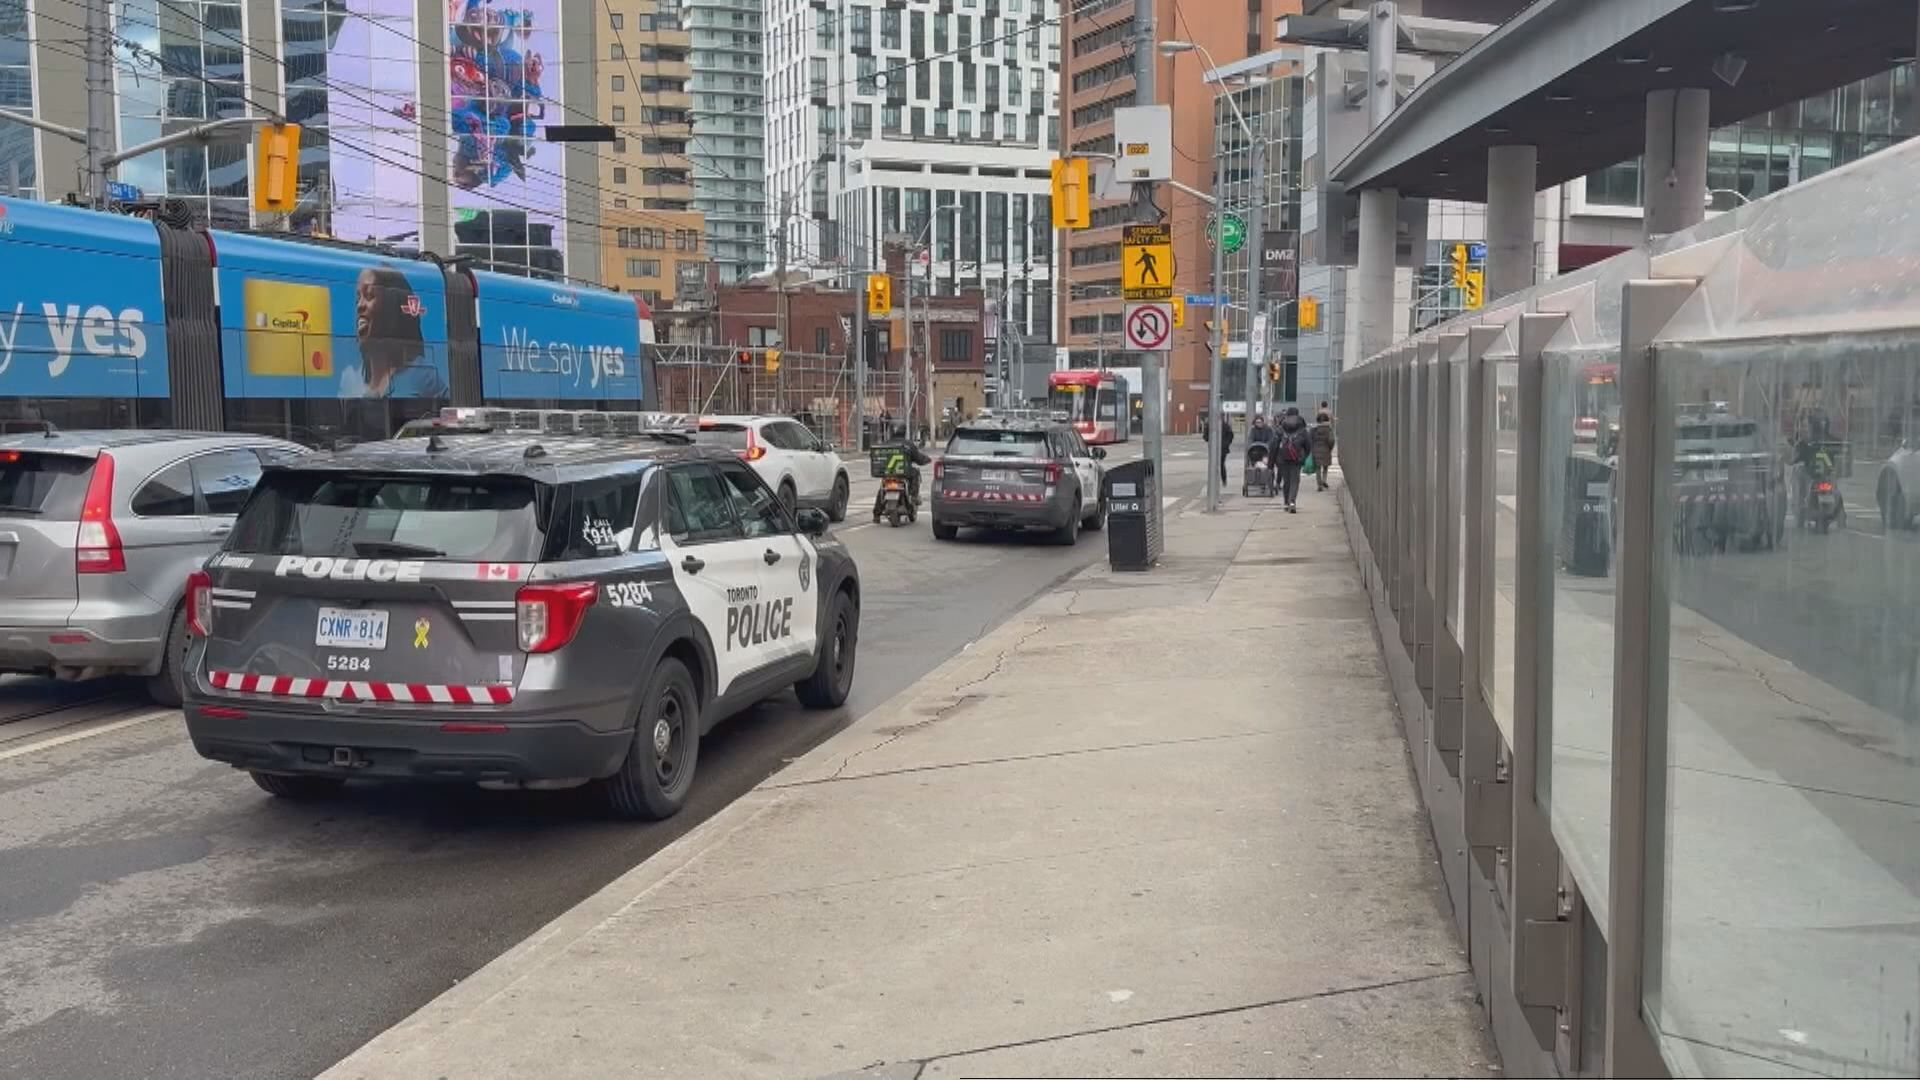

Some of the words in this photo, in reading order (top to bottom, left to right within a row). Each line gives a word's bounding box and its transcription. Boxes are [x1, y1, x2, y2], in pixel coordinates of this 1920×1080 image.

[1265, 249, 1295, 260] DMZ
[42, 302, 147, 378] yes
[502, 325, 540, 372] We
[548, 341, 583, 388] say
[589, 345, 625, 388] yes
[274, 555, 425, 582] POLICE
[606, 581, 653, 607] 5284
[727, 585, 758, 604] TORONTO
[727, 597, 793, 652] POLICE
[327, 654, 371, 672] 5284
